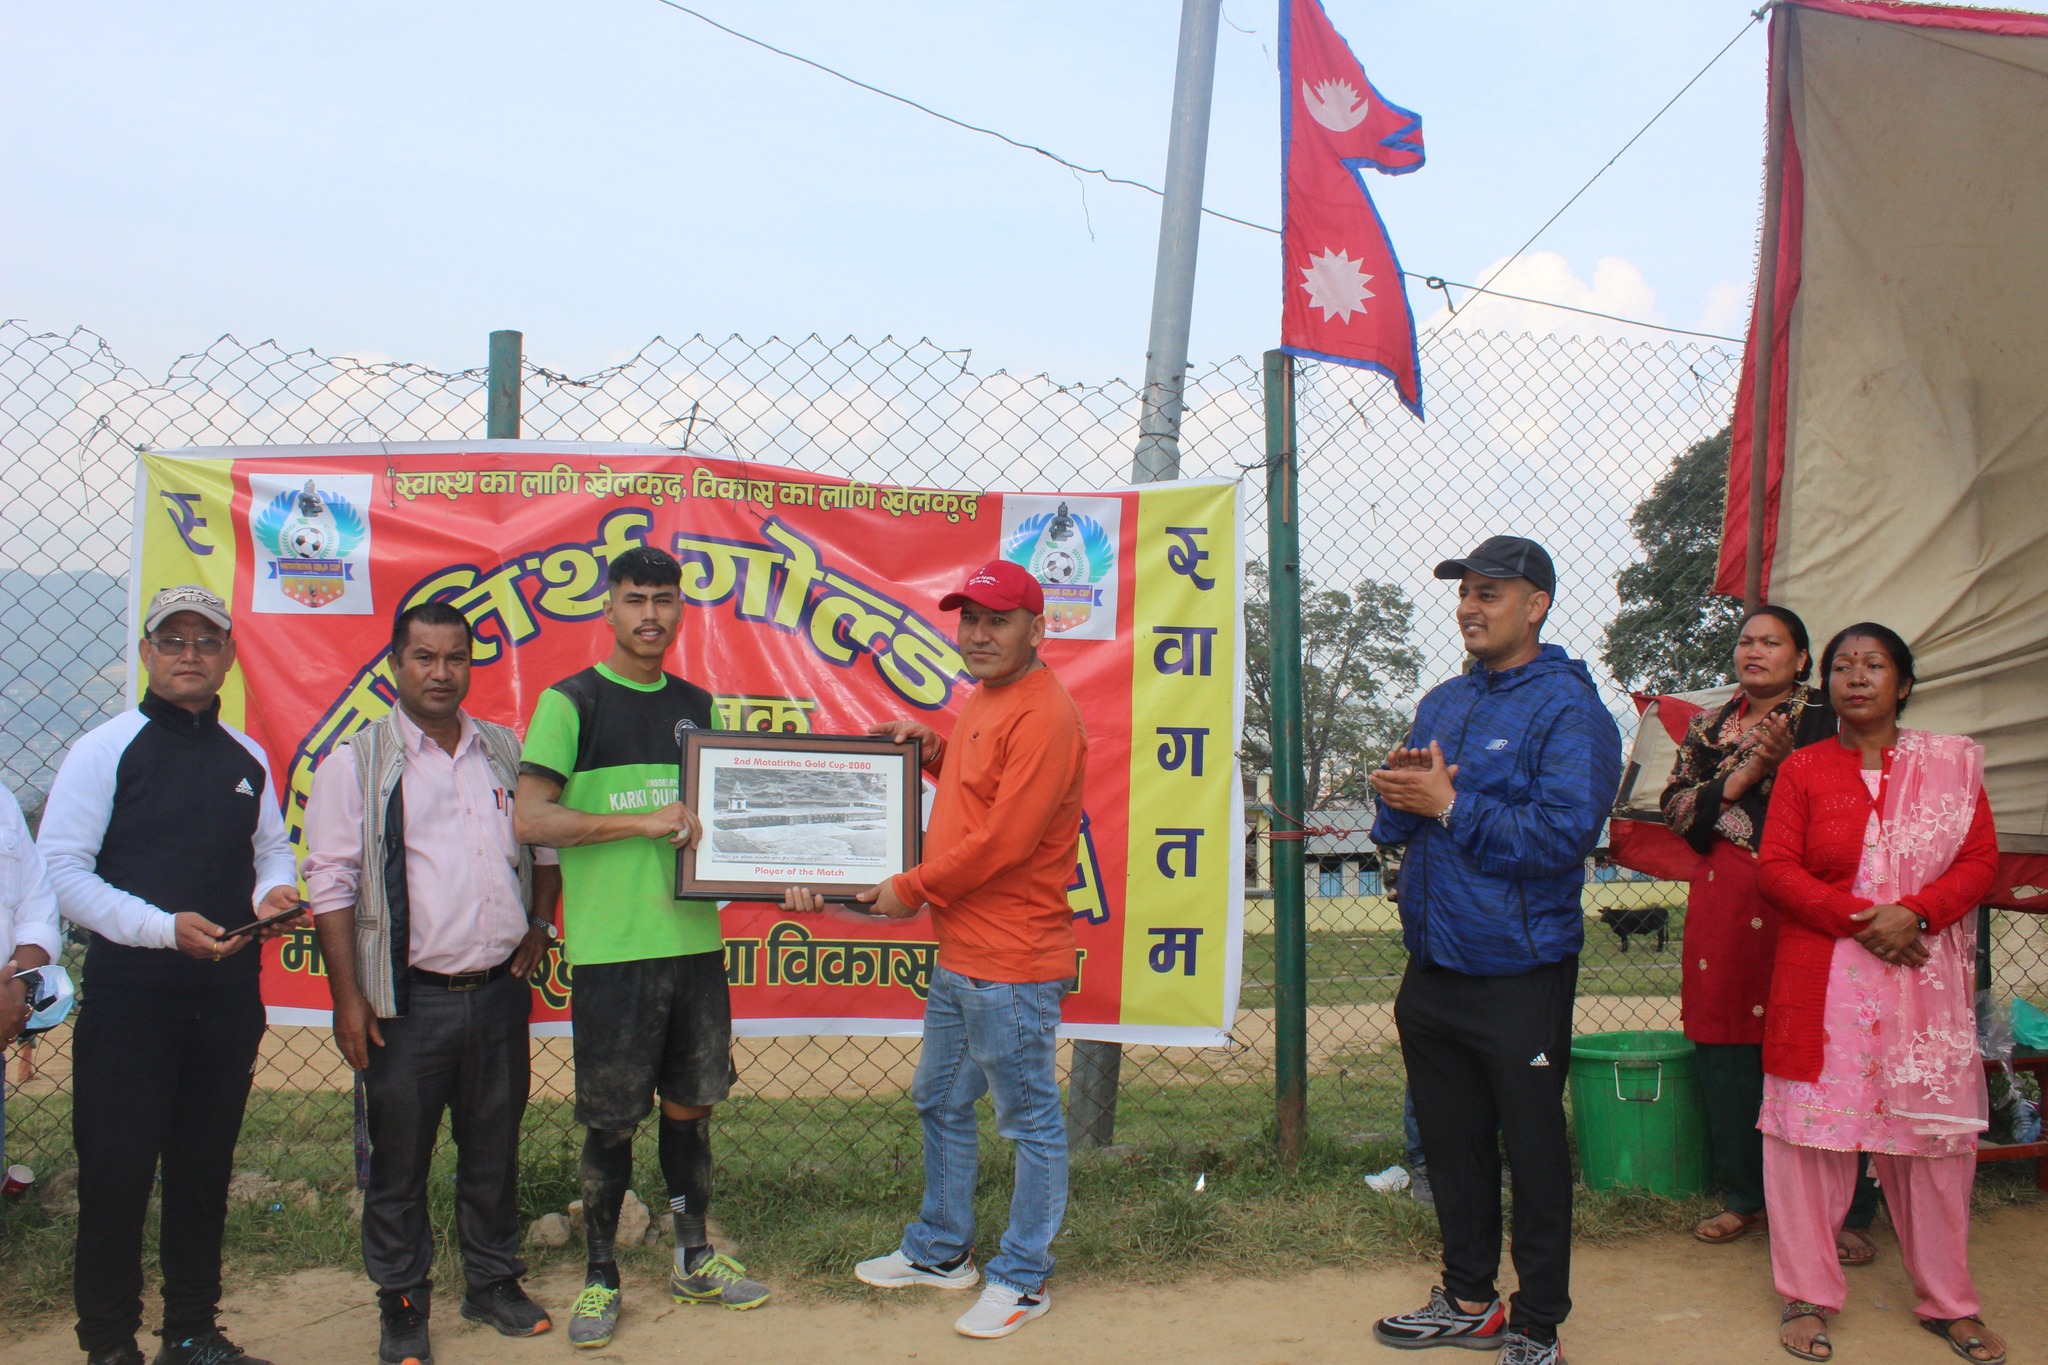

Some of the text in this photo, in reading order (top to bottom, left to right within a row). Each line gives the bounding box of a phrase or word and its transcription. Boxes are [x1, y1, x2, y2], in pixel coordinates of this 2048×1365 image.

[479, 470, 517, 494] का
[520, 463, 580, 498] लागि
[692, 467, 775, 510] विकास
[779, 482, 815, 507] का
[818, 479, 878, 511] लागि
[734, 757, 871, 770] 2nd Matatirtha Gold Cup-2080
[610, 789, 648, 811] KARKI
[754, 866, 845, 877] Player of the Match
